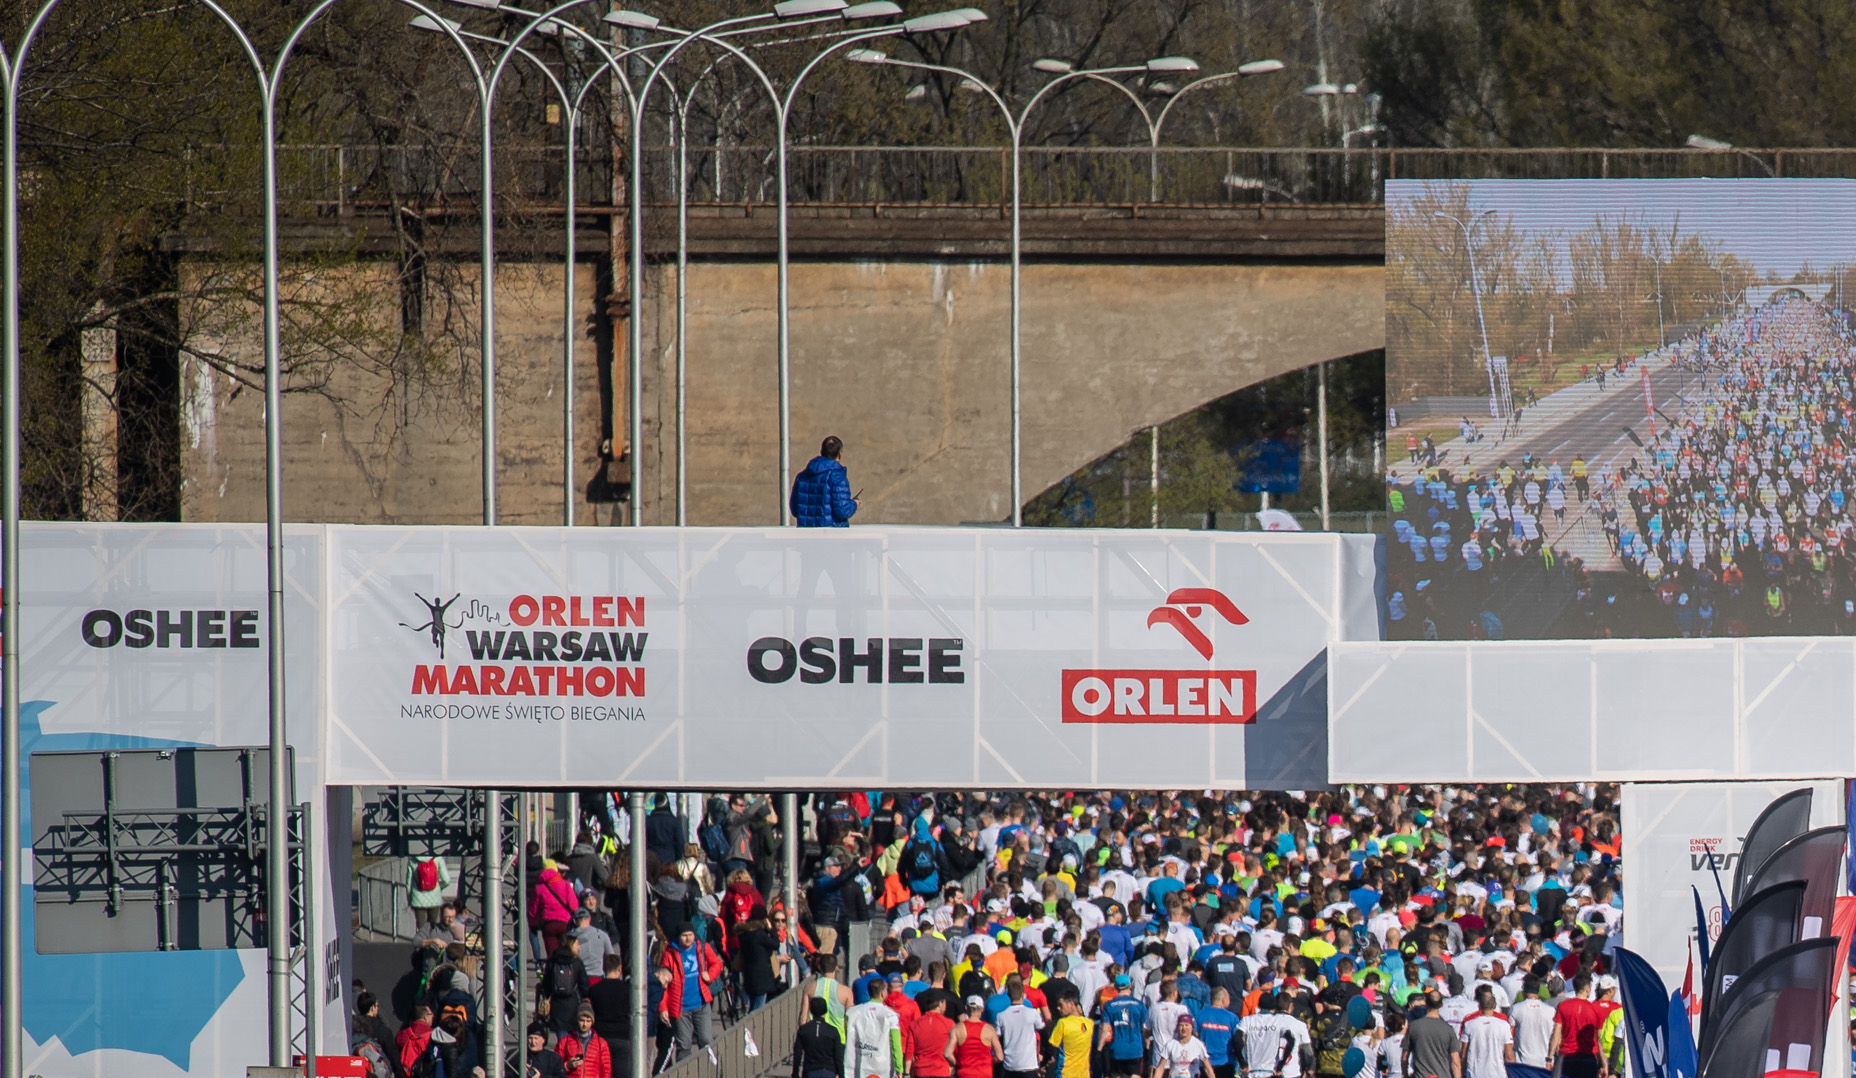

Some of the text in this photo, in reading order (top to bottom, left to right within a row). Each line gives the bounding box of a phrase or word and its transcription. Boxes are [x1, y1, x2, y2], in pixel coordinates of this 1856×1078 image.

[509, 595, 645, 627] ORLEN
[81, 610, 260, 649] OSHEE
[467, 632, 647, 661] WARSAW
[747, 637, 965, 684] OSHEE
[411, 665, 645, 696] MARATHON
[1071, 677, 1244, 716] ORLEN
[400, 703, 645, 724] NARODOWE ŚWIĘTO BIEGANIA
